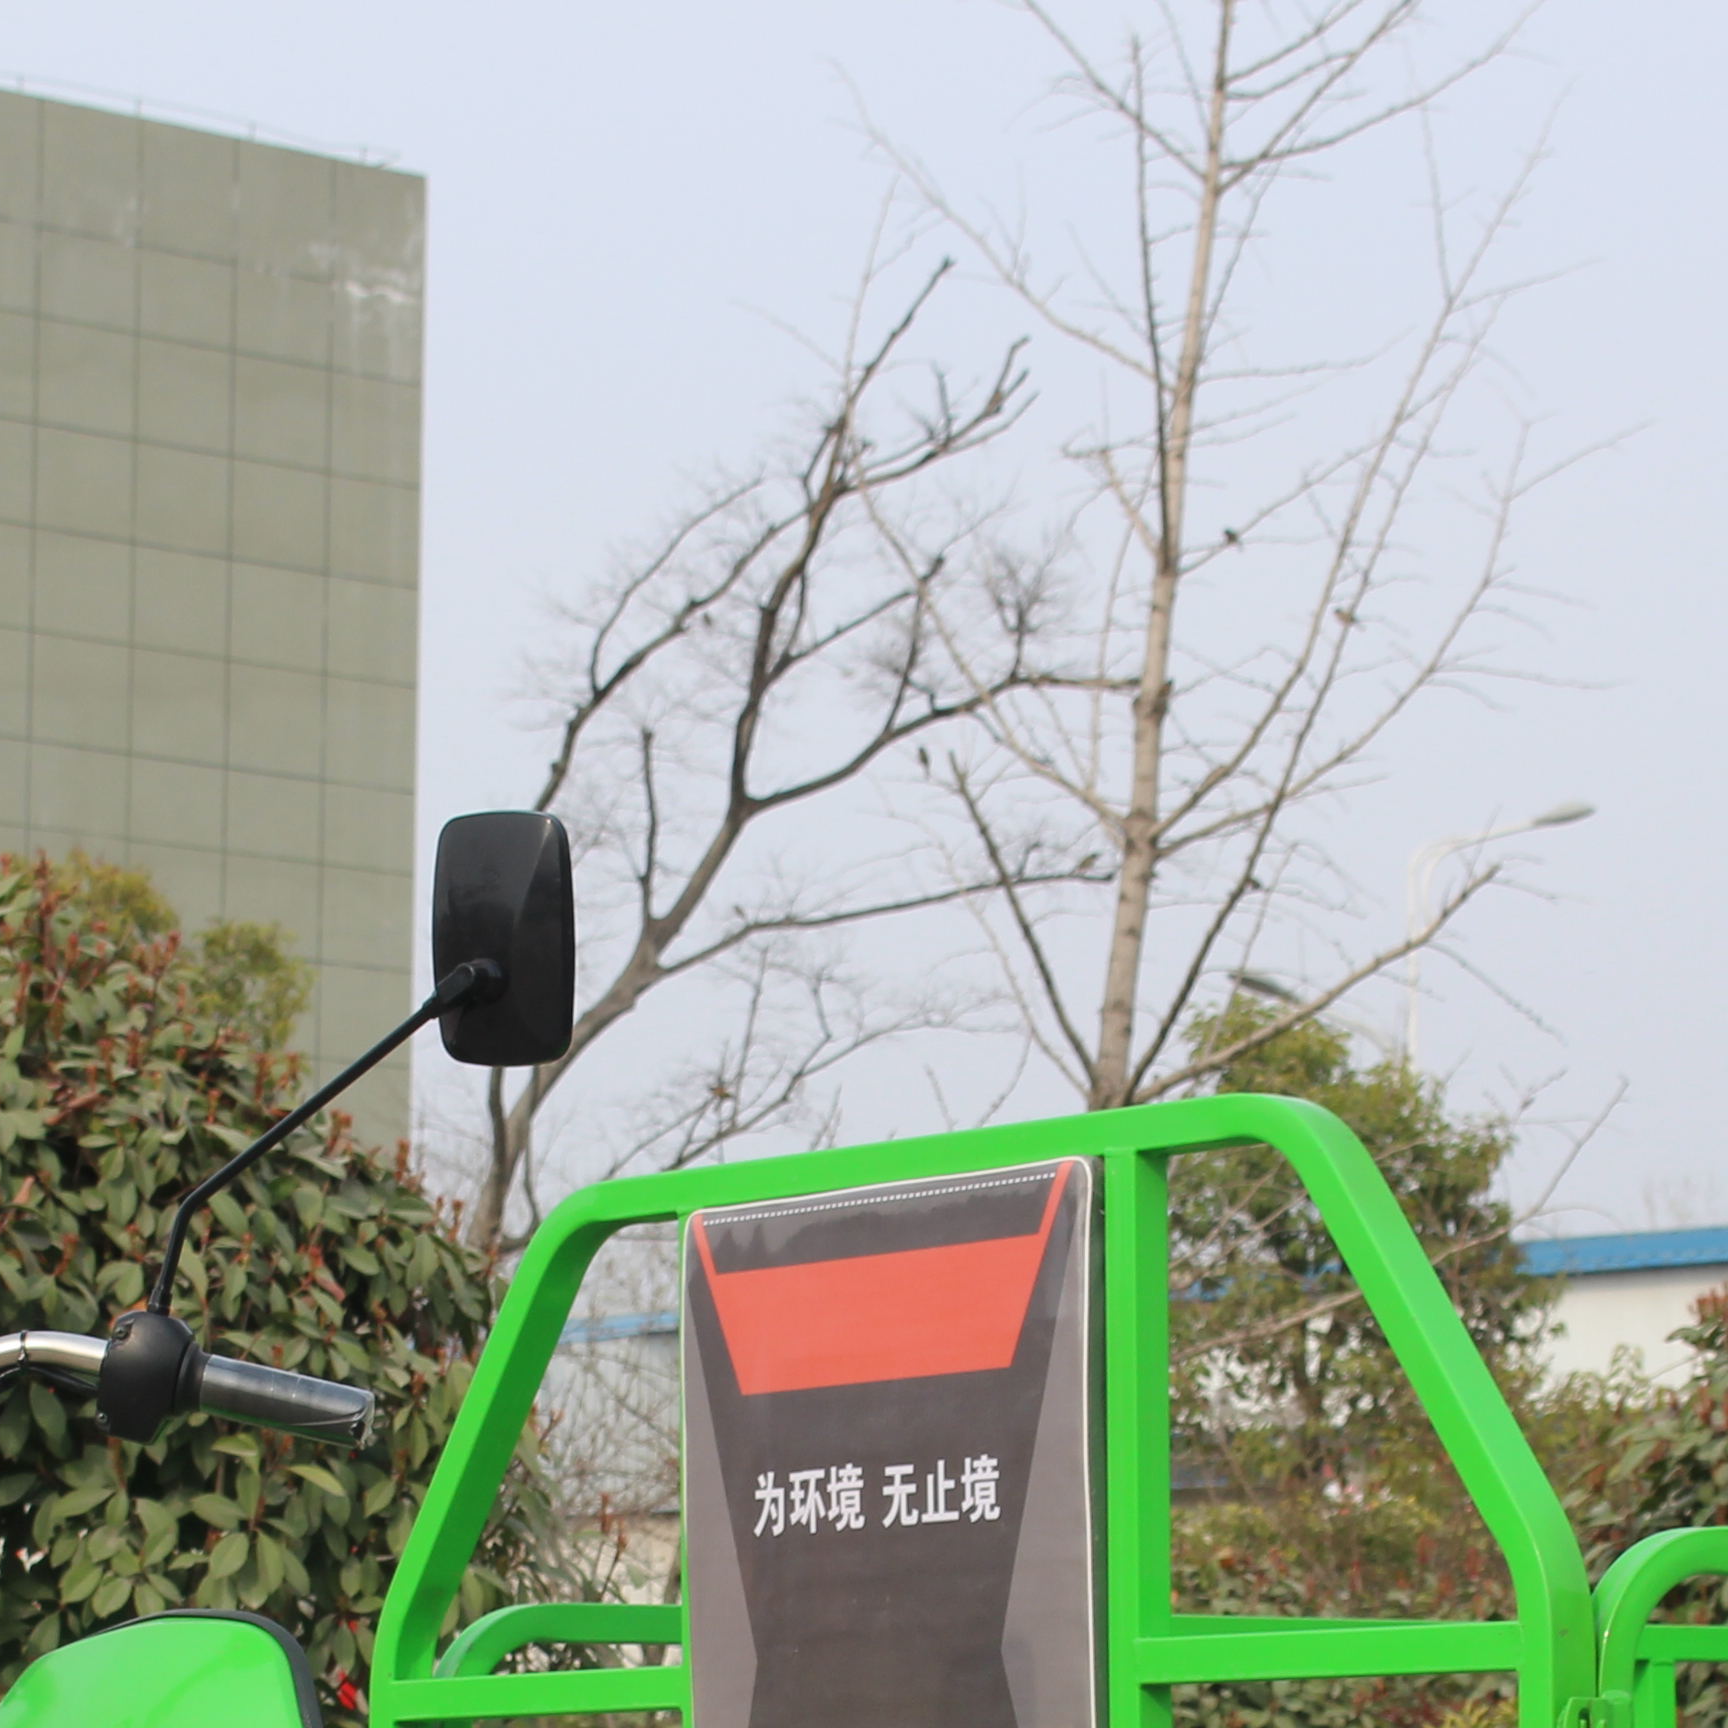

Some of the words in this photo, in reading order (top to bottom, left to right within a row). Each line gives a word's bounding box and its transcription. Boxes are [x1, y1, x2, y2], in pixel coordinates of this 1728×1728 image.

[753, 1462, 865, 1537] 为环境
[882, 1454, 1001, 1528] 无止境
